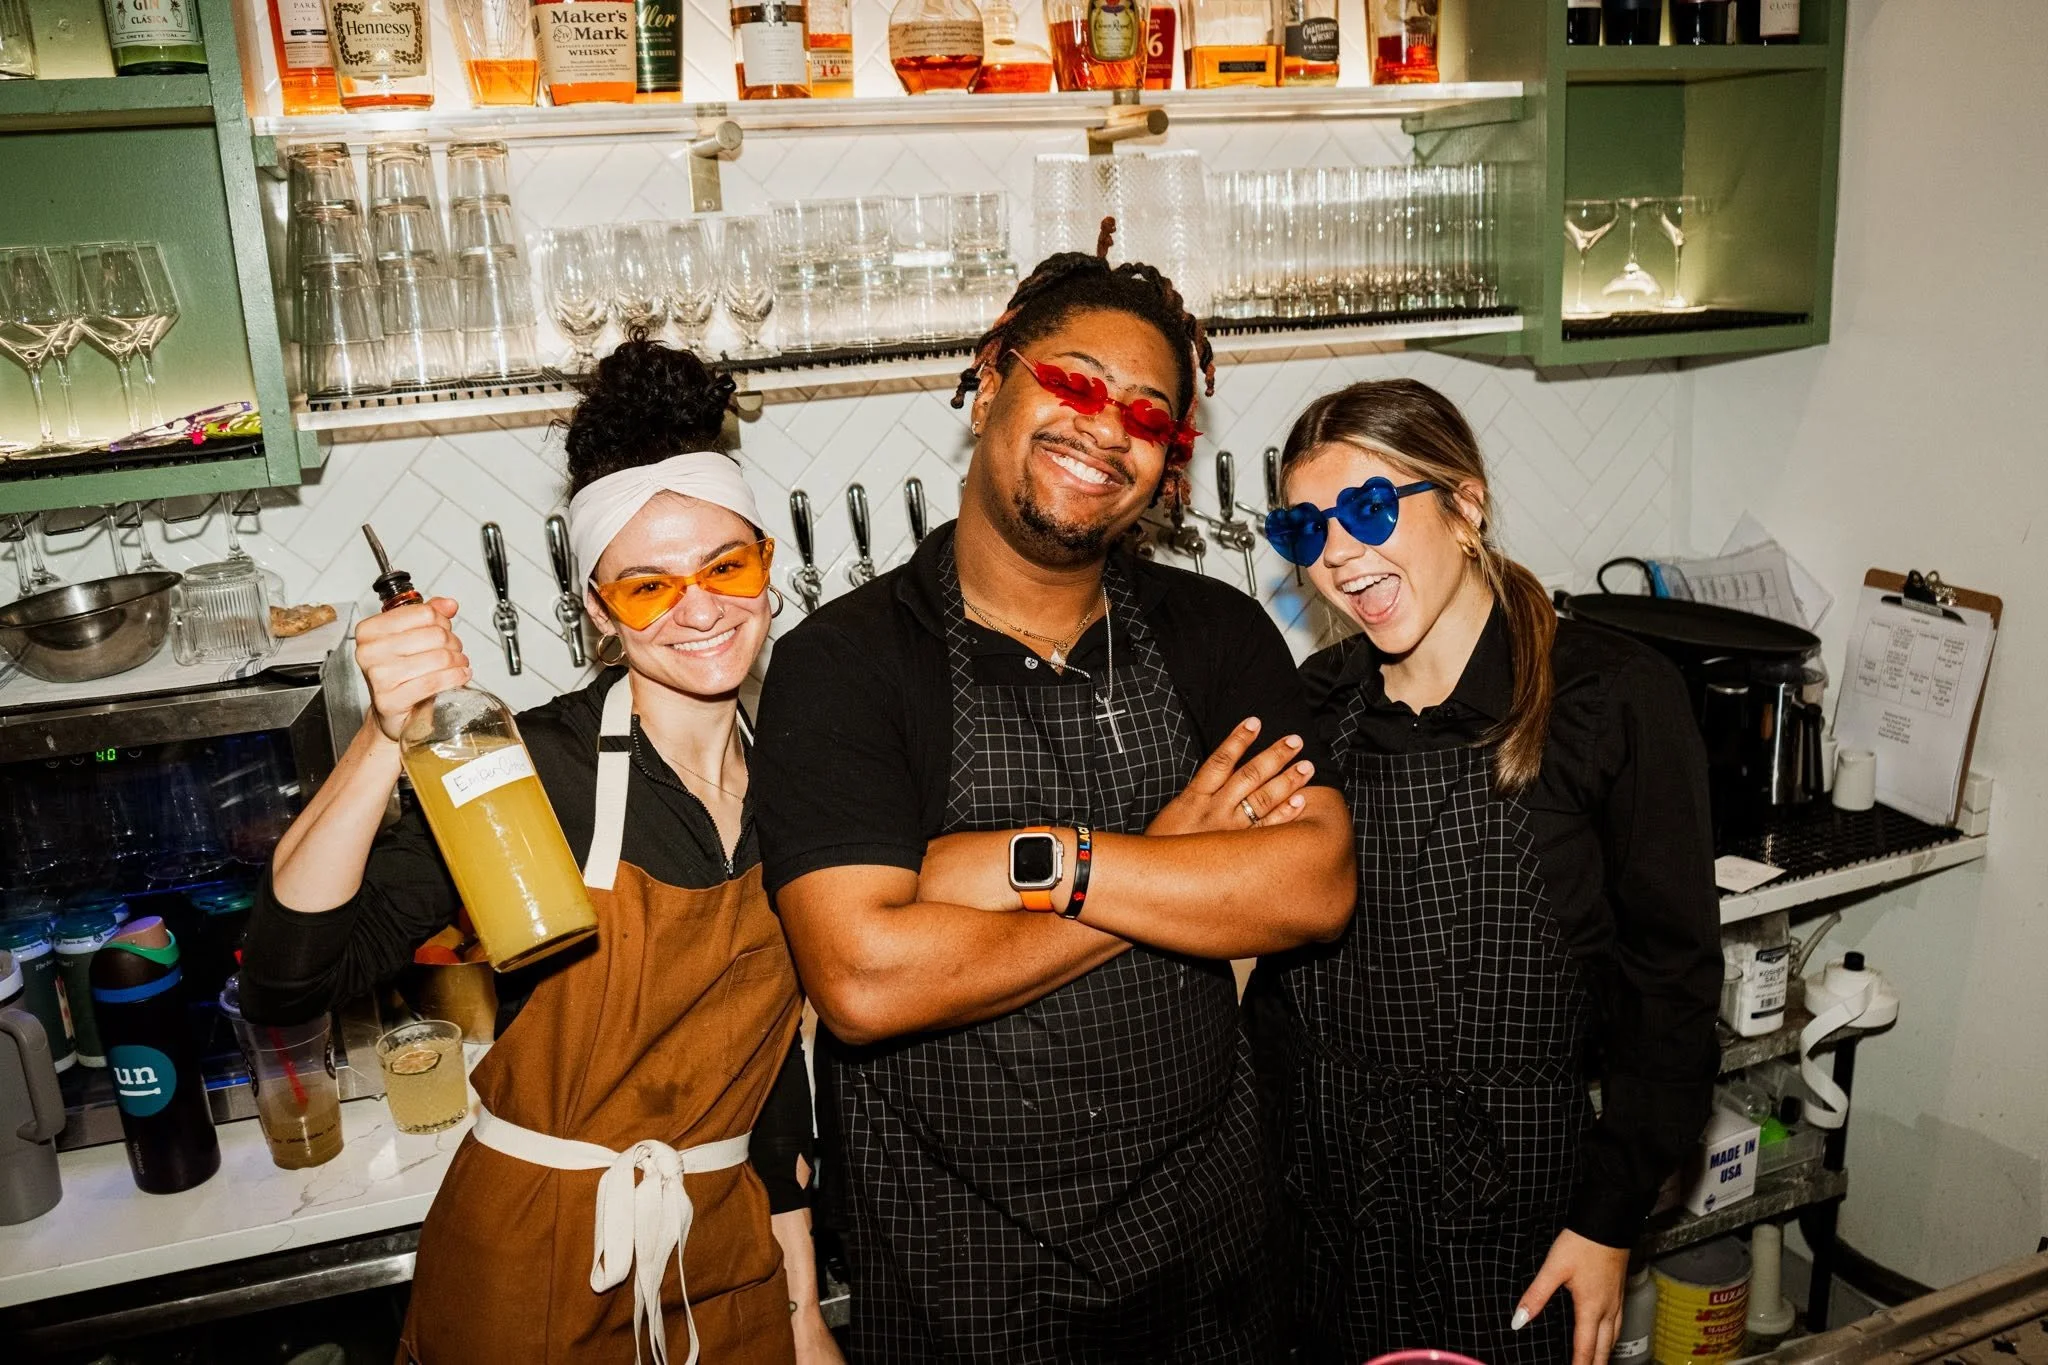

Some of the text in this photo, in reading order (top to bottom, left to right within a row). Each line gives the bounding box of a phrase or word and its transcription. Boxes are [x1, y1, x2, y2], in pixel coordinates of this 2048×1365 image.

[551, 10, 628, 24] Maker's
[638, 5, 676, 27] ller
[346, 20, 412, 37] Hennessy
[574, 26, 628, 40] Mark
[568, 48, 617, 56] WHISKY
[820, 64, 840, 77] 10
[96, 748, 116, 761] 40
[1078, 826, 1090, 861] BLAC
[1710, 1138, 1756, 1170] MADE IN
[1720, 1163, 1742, 1184] USA
